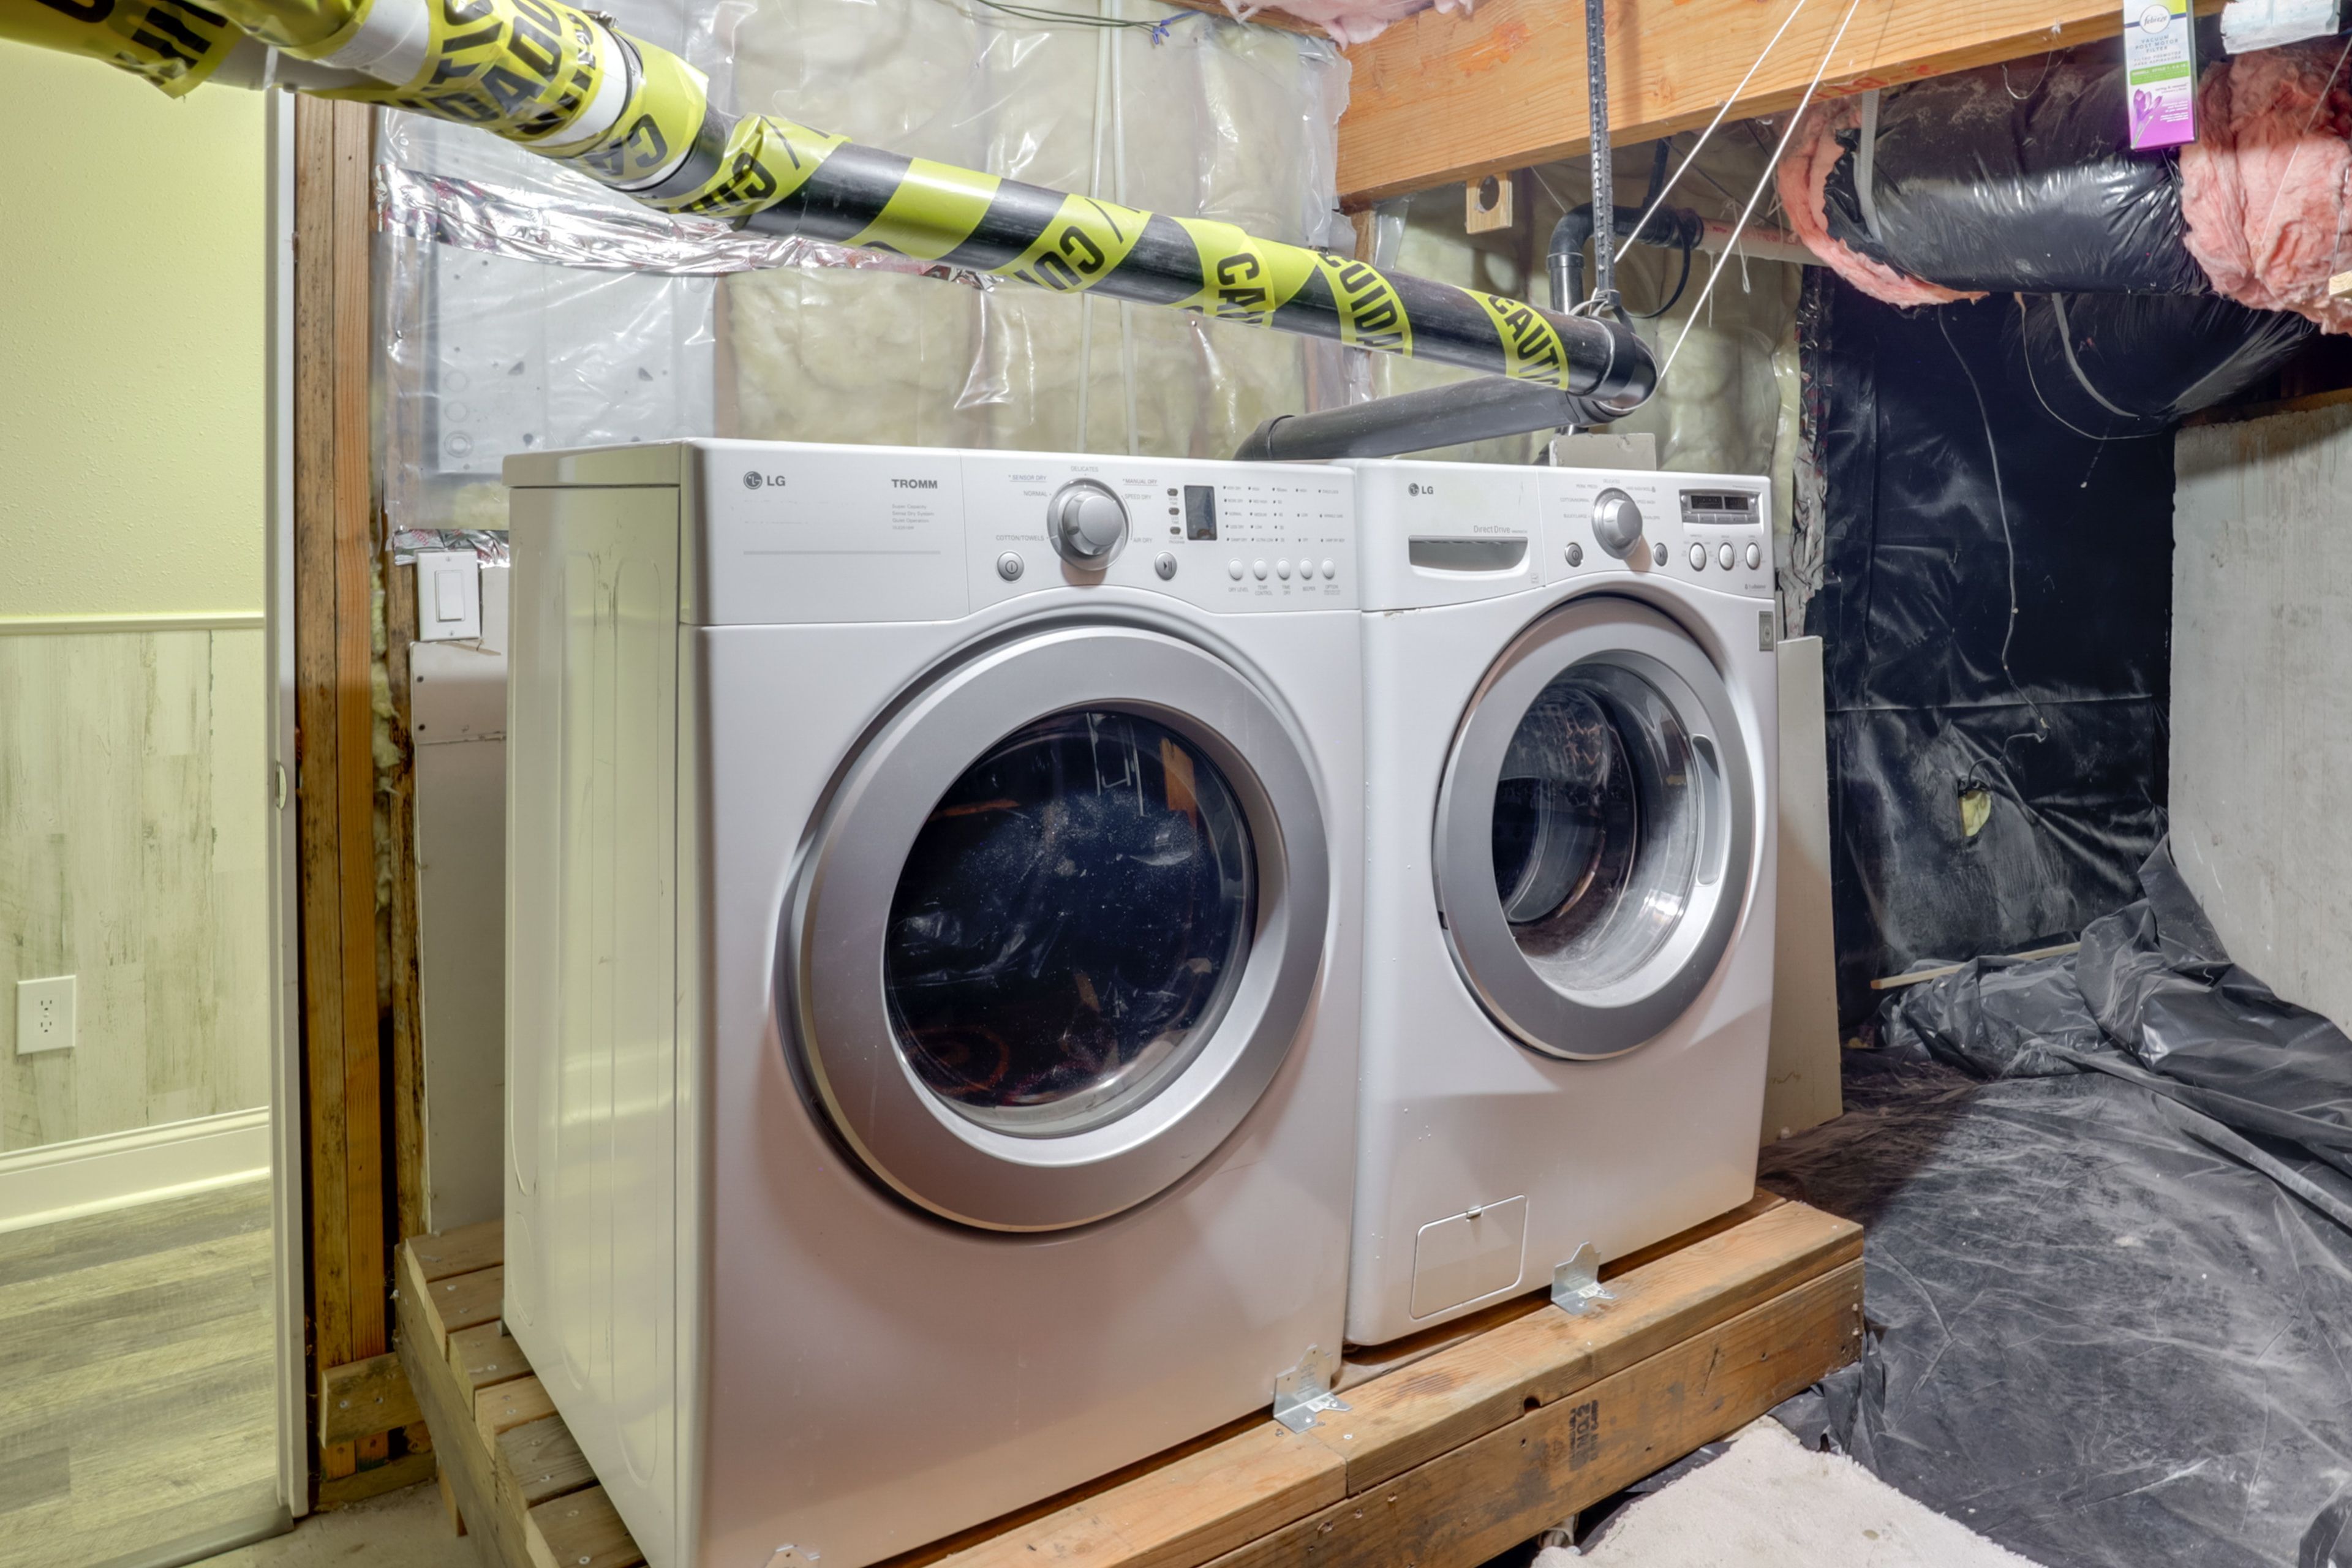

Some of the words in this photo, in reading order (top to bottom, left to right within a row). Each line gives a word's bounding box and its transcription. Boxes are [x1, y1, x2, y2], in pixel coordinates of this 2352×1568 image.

[2141, 35, 2169, 43] VACUUM
[767, 475, 786, 487] LG
[891, 479, 938, 489] TROMM
